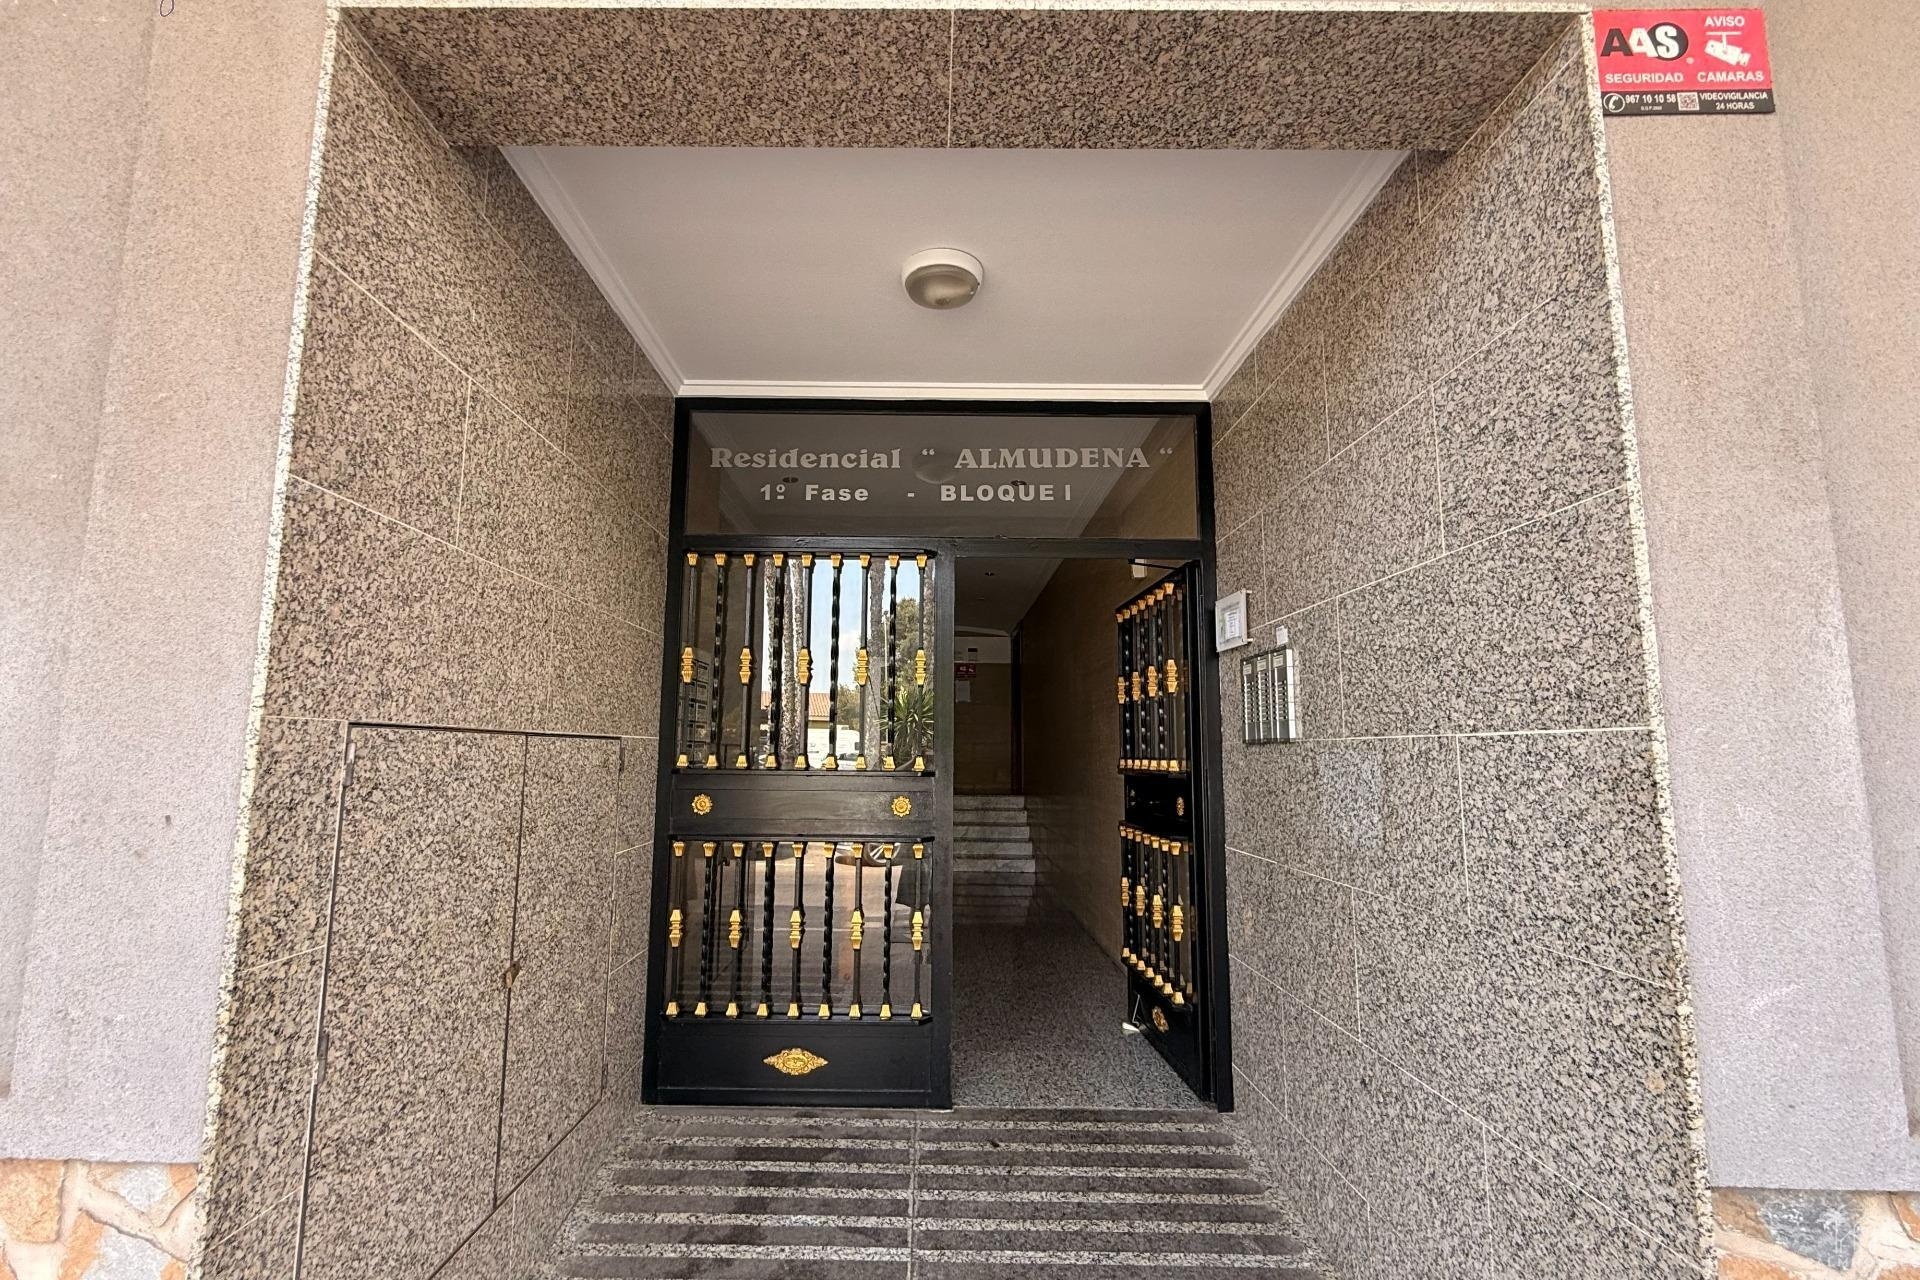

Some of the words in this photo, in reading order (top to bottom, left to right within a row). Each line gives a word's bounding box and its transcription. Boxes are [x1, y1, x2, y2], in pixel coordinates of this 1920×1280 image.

[1704, 16, 1745, 27] AVISO
[1601, 25, 1681, 59] AAS
[1605, 73, 1684, 83] SEGURIDAD
[1697, 71, 1764, 82] CAMARAS
[1625, 94, 1640, 103] 967
[1642, 94, 1652, 103] 10
[1654, 94, 1664, 103] 10
[1666, 94, 1676, 103] 58
[1699, 92, 1768, 100] VIDEOVIGILANCIA
[1715, 102, 1725, 110] 24
[1726, 102, 1755, 110] HORAS
[710, 448, 901, 469] Residencial
[954, 447, 1150, 469] ALMUDENA
[805, 484, 869, 501] Fase
[940, 484, 1054, 502] BLOQUE
